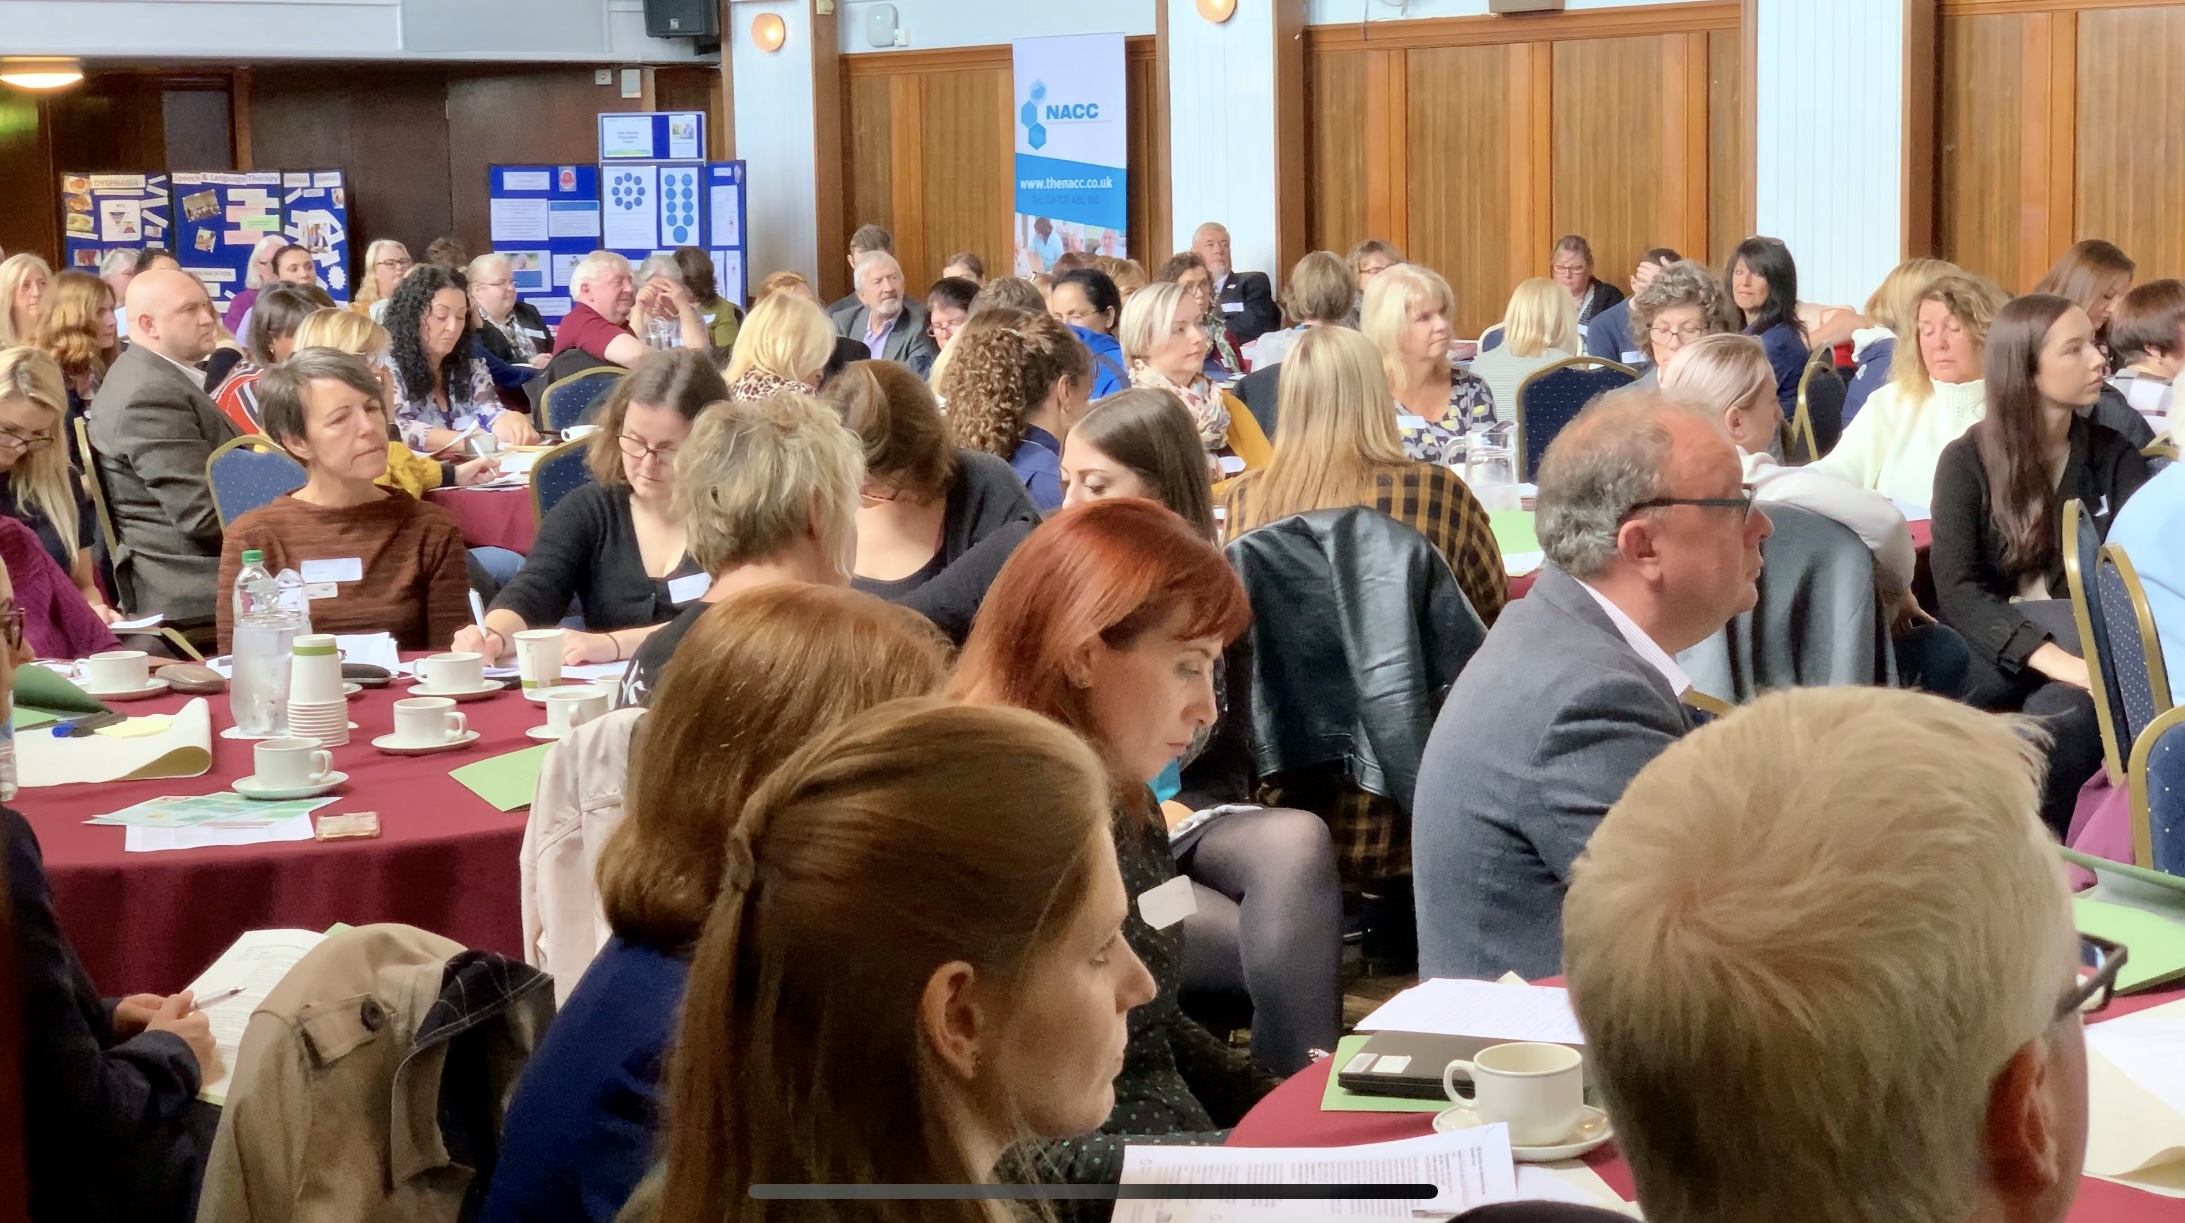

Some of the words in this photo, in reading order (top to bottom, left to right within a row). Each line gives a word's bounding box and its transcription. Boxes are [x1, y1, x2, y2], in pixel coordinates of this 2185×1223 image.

[1046, 103, 1099, 120] NACC
[94, 179, 139, 187] DYSPHAGIA
[174, 174, 200, 184] Speech
[202, 173, 208, 181] &
[210, 174, 246, 185] Language
[248, 174, 279, 184] Therapy
[1020, 176, 1113, 189] www.thenacc.co.uk
